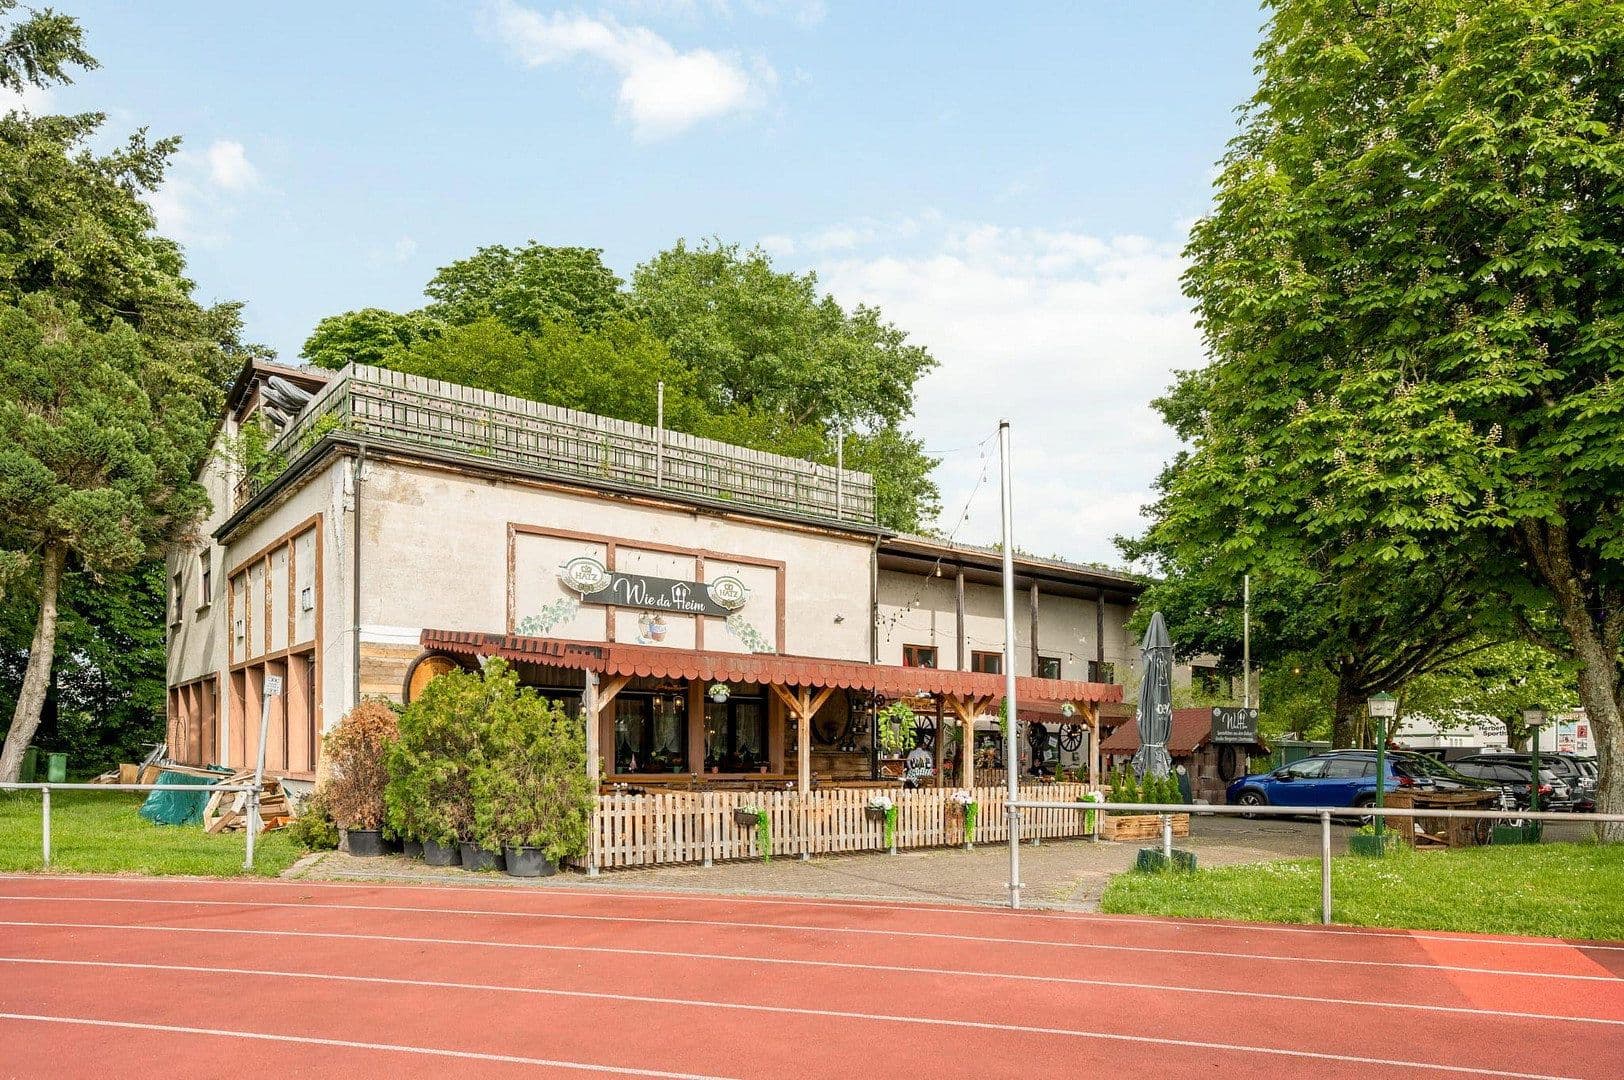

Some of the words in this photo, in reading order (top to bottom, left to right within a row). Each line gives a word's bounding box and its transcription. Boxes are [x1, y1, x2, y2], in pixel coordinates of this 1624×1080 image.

[575, 571, 598, 581] HATZ
[613, 577, 655, 605] Wie
[656, 593, 672, 608] da
[671, 582, 706, 612] Heim
